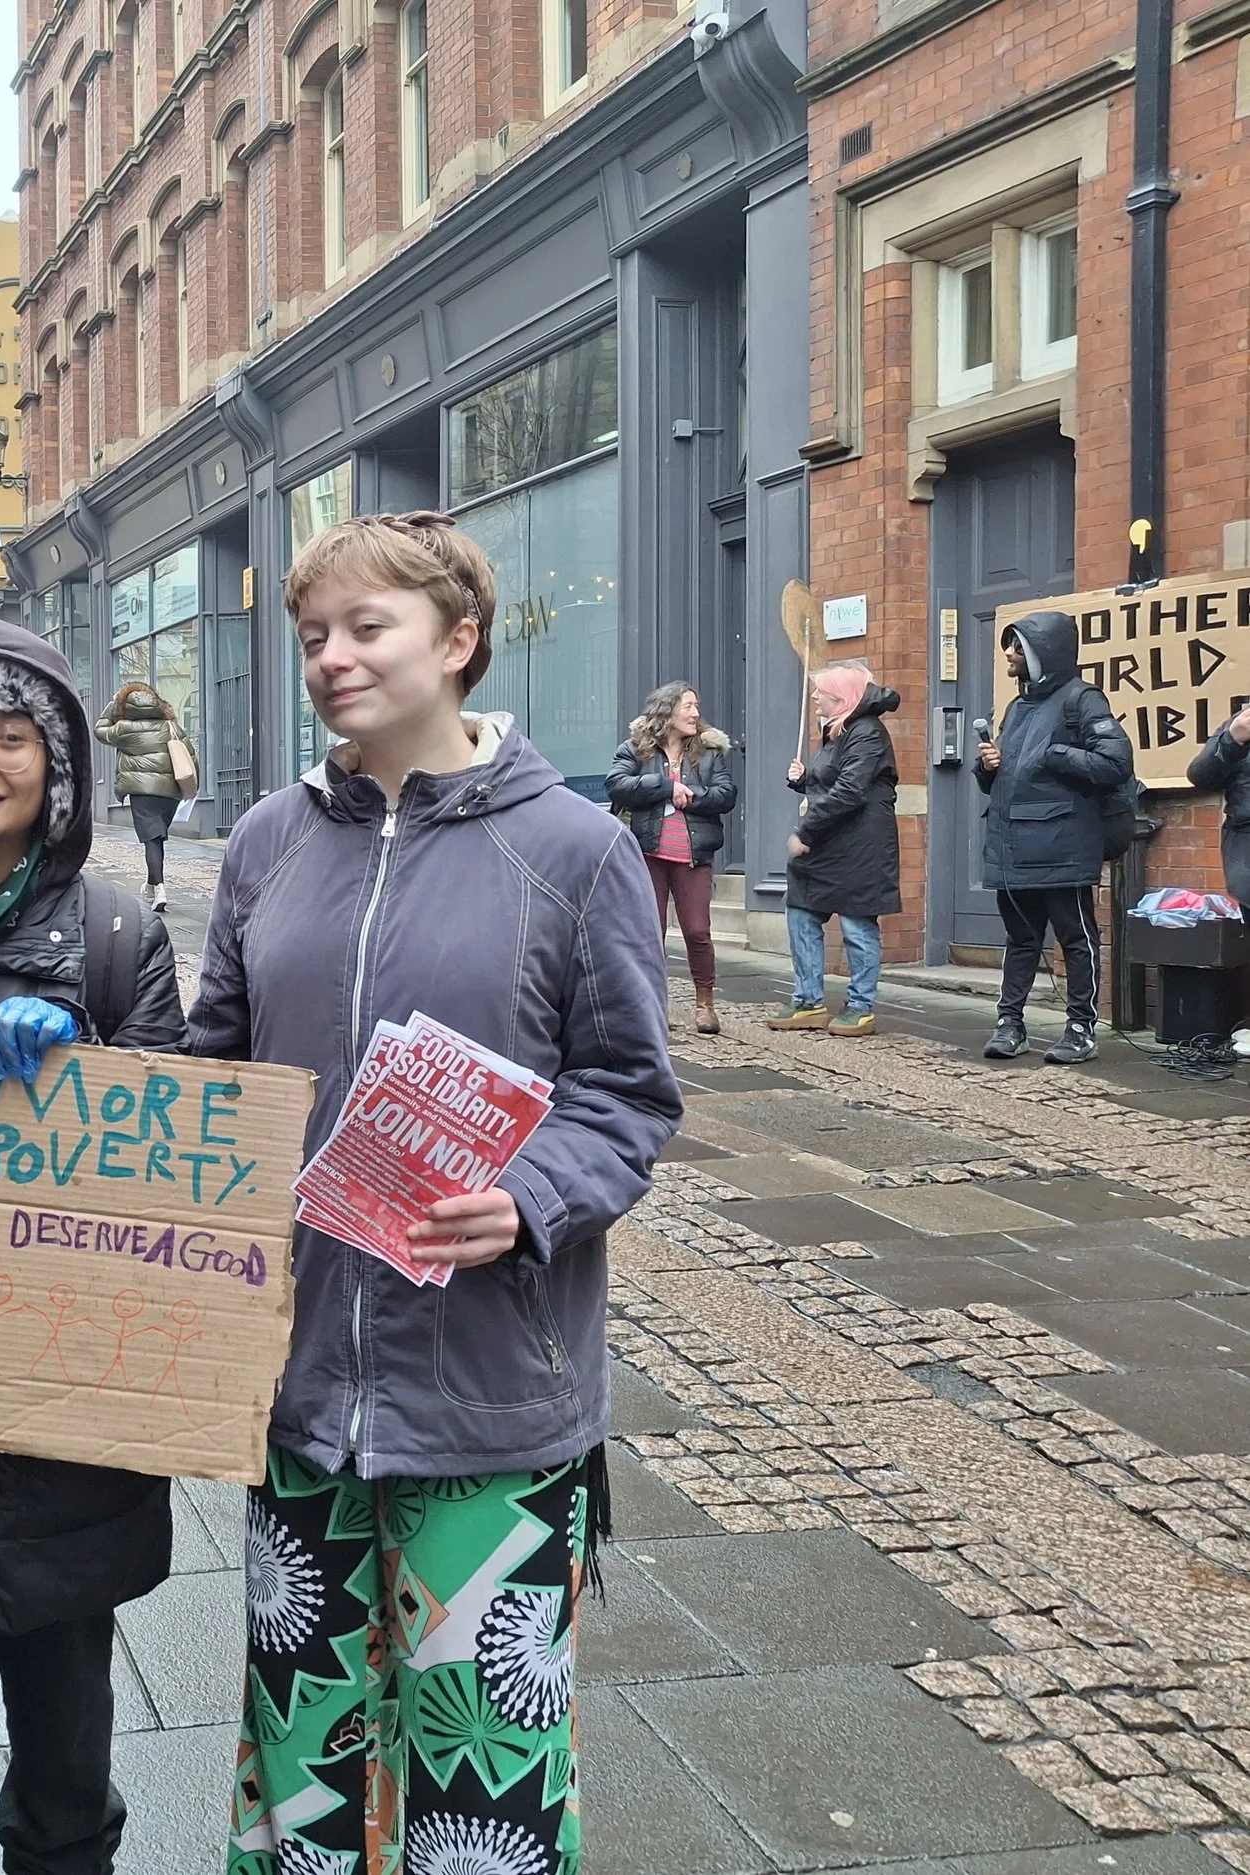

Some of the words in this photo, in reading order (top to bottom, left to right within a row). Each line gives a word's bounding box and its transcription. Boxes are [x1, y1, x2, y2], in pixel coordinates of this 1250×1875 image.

[1071, 587, 1250, 645] OTHE
[409, 1029, 470, 1078] FOOD
[466, 1066, 489, 1090] &
[386, 1072, 417, 1097] Towards
[416, 1093, 427, 1103] an
[427, 1100, 463, 1126] organised
[393, 1052, 518, 1138] SOLIDARITY
[421, 1108, 436, 1121] and
[350, 1116, 376, 1138] What
[375, 1133, 388, 1147] we
[356, 1096, 434, 1155] JOIN
[423, 1133, 500, 1193] NOW
[314, 1158, 347, 1184] CONTACTS
[10, 1207, 148, 1257] DESERVE
[142, 1222, 175, 1270] A
[179, 1231, 268, 1287] GOOD
